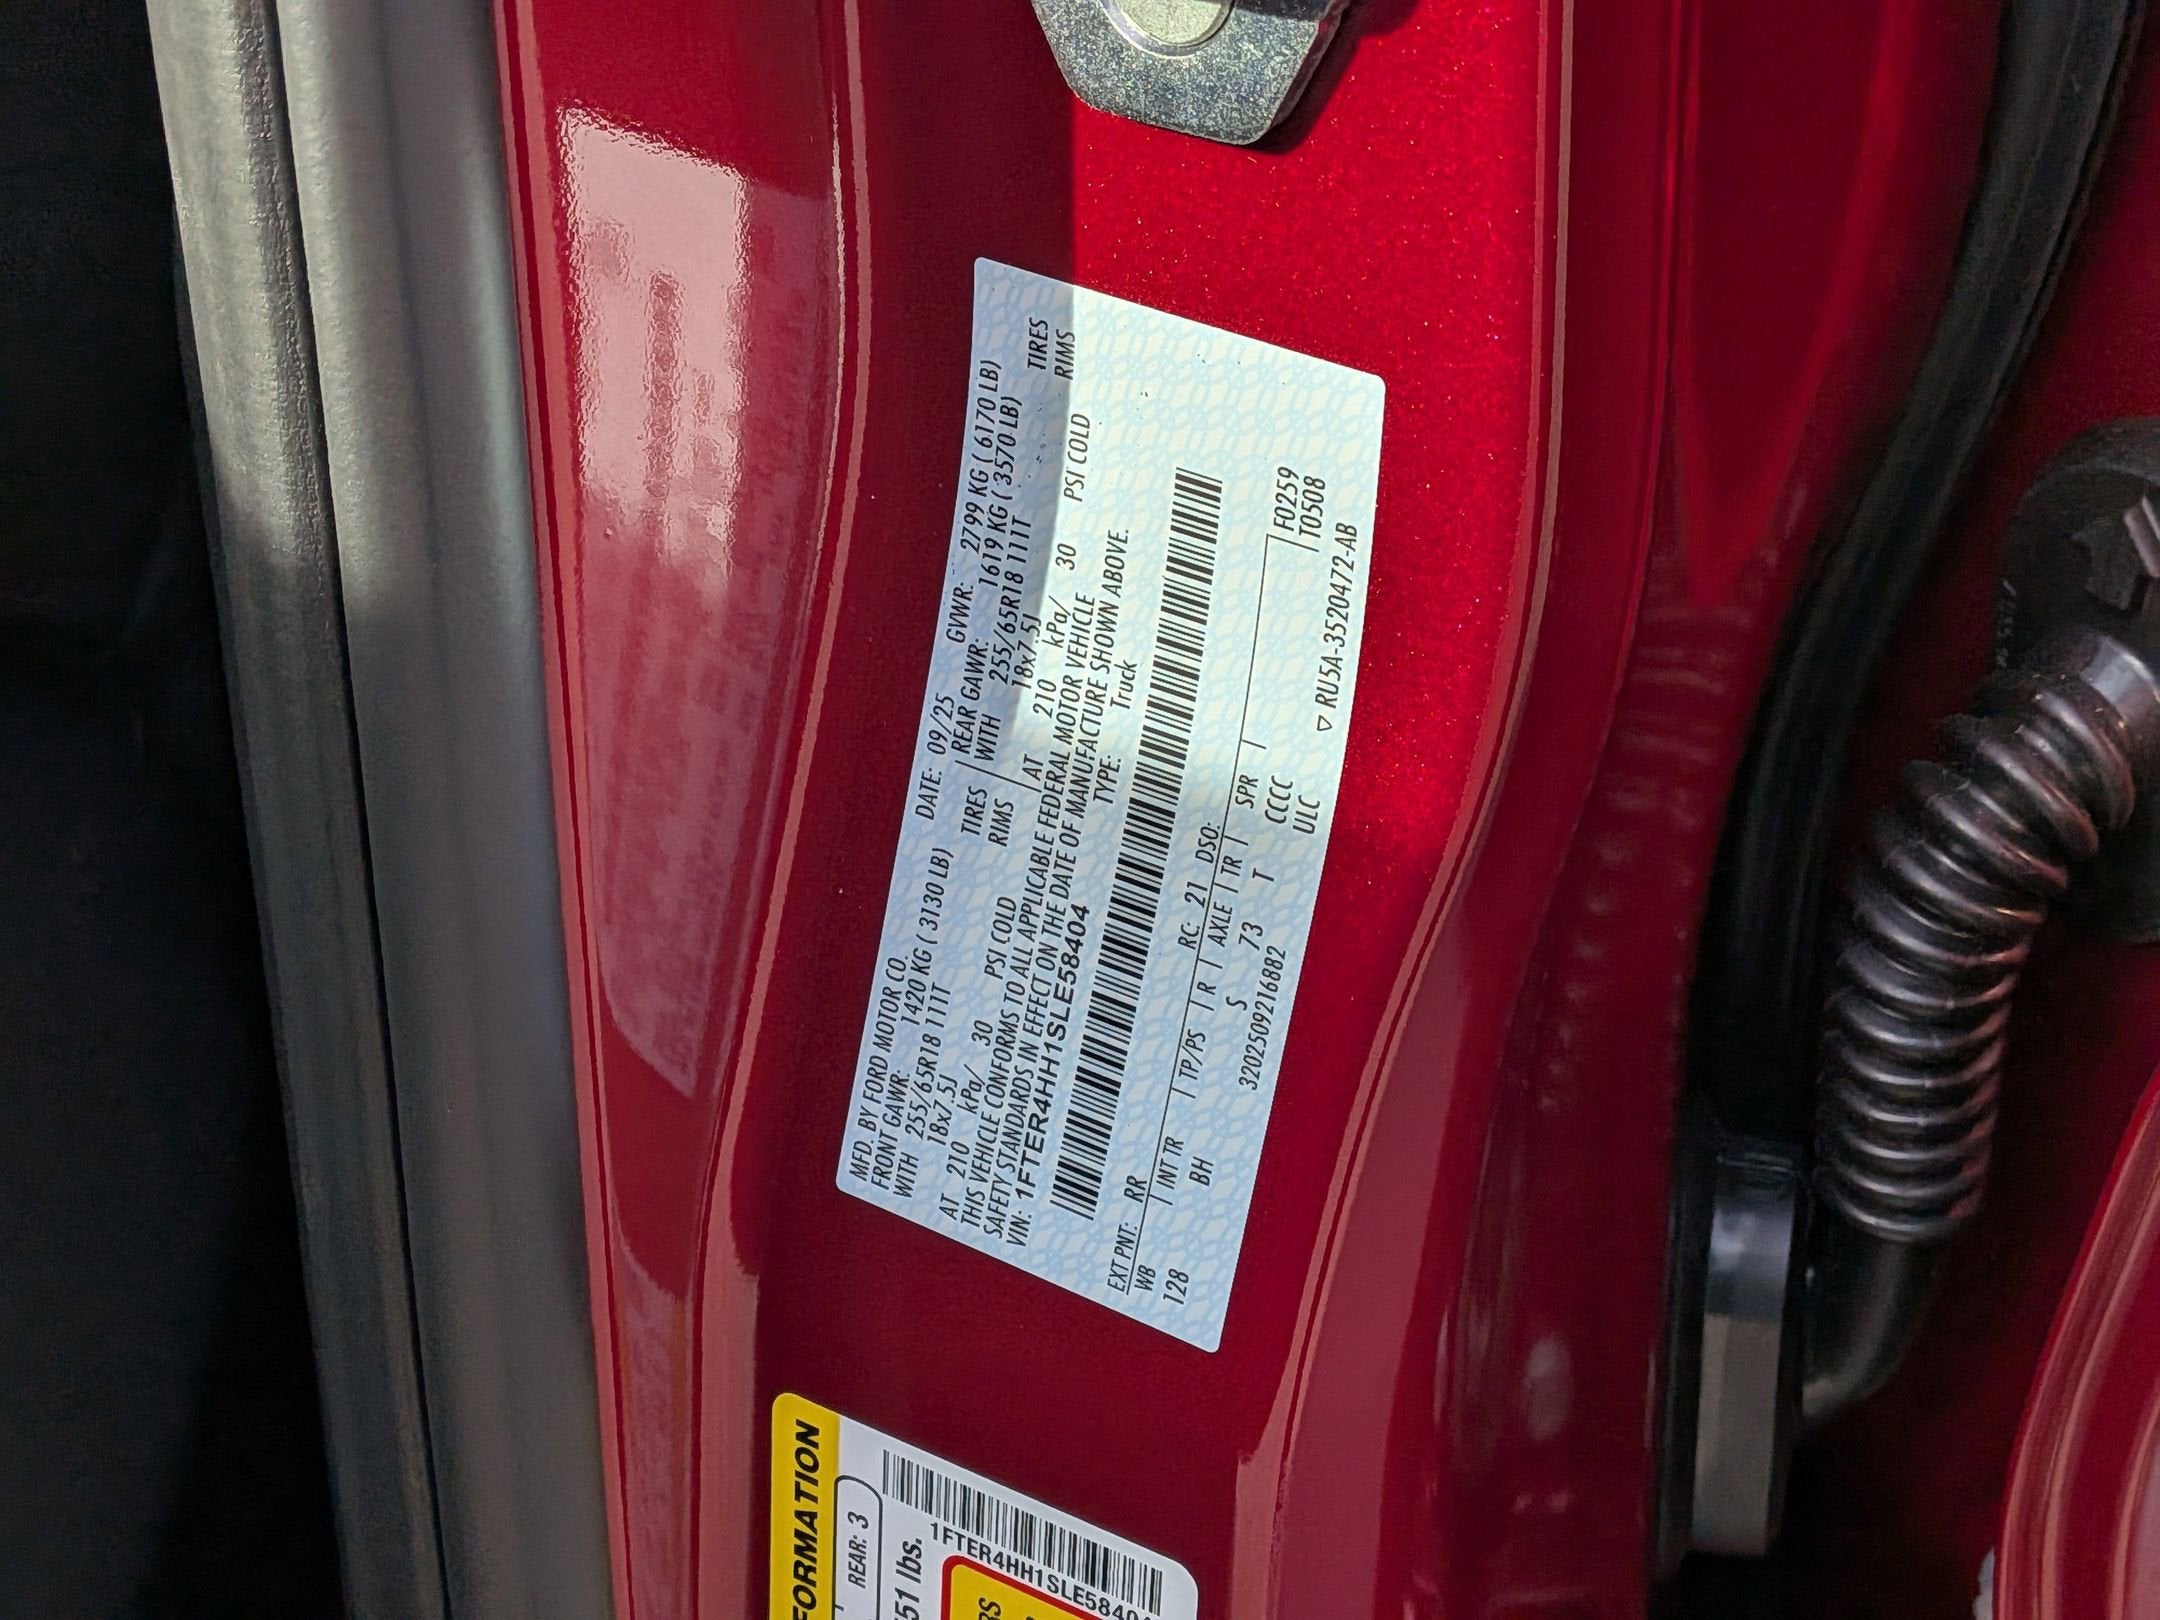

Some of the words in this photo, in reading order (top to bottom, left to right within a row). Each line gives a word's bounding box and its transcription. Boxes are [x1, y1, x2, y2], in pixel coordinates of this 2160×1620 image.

[1027, 317, 1049, 370] TIRES
[1054, 328, 1076, 381] RIMS
[978, 359, 1002, 393] LB)
[973, 396, 997, 449] 6170
[998, 395, 1023, 430] LB)
[992, 432, 1017, 486] 3570
[1067, 413, 1091, 465] COLD
[967, 468, 989, 498] KG
[1063, 469, 1086, 503] PSI
[1273, 466, 1300, 532] F0259
[1298, 475, 1326, 539] T0508
[959, 501, 985, 555] 2799
[986, 503, 1009, 534] KG
[978, 537, 1004, 588] 1619
[1055, 543, 1077, 571] 30
[1101, 529, 1129, 599] ABOVE.
[945, 582, 974, 644] GVWR:
[1041, 595, 1072, 649] kPa/
[1064, 592, 1096, 669] VEHICLE
[1314, 522, 1358, 709] RU5A-3520472-AB
[973, 713, 1001, 762] WITH
[988, 570, 1024, 686] 255/65R18
[1006, 514, 1032, 564] 111T
[1011, 612, 1042, 690] 18x7.5J
[1089, 600, 1120, 675] SHOWN
[959, 638, 989, 702] GAWR:
[1032, 678, 1057, 719] 210
[1052, 674, 1084, 746] MOTOR
[926, 692, 955, 755] 09/25
[950, 705, 978, 755] REAR
[1092, 754, 1122, 805] TYPE:
[1109, 659, 1138, 710] Truck
[1021, 753, 1044, 782] AT
[1064, 677, 1108, 820] MANUFACTURE
[914, 767, 943, 821] DATE:
[960, 785, 988, 836] TIRES
[1037, 750, 1071, 830] FEDERAL
[1234, 774, 1259, 810] SPR
[1264, 775, 1294, 825] CCCC
[987, 798, 1014, 848] RIMS
[1058, 819, 1082, 848] OF
[1292, 794, 1321, 835] ULC
[927, 847, 955, 880] LB)
[1194, 822, 1221, 864] DSO:
[1220, 855, 1243, 877] TR
[1016, 830, 1055, 944] APPLICABLE
[1048, 849, 1077, 900] DATE
[1183, 881, 1208, 909] 21
[1251, 867, 1275, 882] T
[918, 881, 945, 932] 3130
[990, 896, 1017, 945] COLD
[1040, 901, 1067, 938] THE
[1207, 900, 1233, 948] AXLE
[1035, 941, 1059, 972] ON
[1177, 921, 1201, 951] RC:
[1238, 921, 1264, 951] 73
[885, 956, 909, 983] CO.
[910, 947, 933, 977] KG
[983, 947, 1008, 980] PSI
[1009, 946, 1034, 980] ALL
[900, 978, 927, 1026] 1420
[925, 981, 951, 1028] 111T
[1002, 980, 1026, 1006] TO
[1022, 972, 1053, 1038] EFFECT
[1196, 981, 1217, 996] R
[1225, 995, 1248, 1011] S
[872, 986, 903, 1054] MOTOR
[970, 1019, 994, 1047] 30
[1238, 945, 1286, 1091] 3202509216882
[983, 1008, 1021, 1109] CONFORMS
[1014, 903, 1091, 1200] 1FTER4HH1SLE58404
[1016, 1039, 1040, 1064] IN
[1178, 1028, 1206, 1081] TP/PS
[862, 1054, 889, 1105] FORD
[881, 1069, 911, 1128] GAWR:
[904, 1033, 942, 1140] 255/65R18
[956, 1063, 986, 1115] kPa/
[857, 1104, 879, 1133] BY
[926, 1073, 958, 1146] 18x7.5J
[995, 1064, 1035, 1174] STANDARDS
[848, 1140, 874, 1182] MFD.
[870, 1128, 898, 1191] FRONT
[945, 1140, 971, 1180] 210
[968, 1110, 1001, 1184] VEHICLE
[1162, 1135, 1185, 1157] TR
[892, 1151, 919, 1198] WITH
[1123, 1175, 1148, 1204] RR
[1155, 1157, 1179, 1190] INT
[1188, 1155, 1214, 1187] BH
[938, 1192, 960, 1221] AT
[960, 1186, 986, 1228] THIS
[982, 1171, 1013, 1239] SAFETY
[1005, 1210, 1032, 1247] VIN:
[1113, 1222, 1138, 1261] PNT:
[1106, 1258, 1129, 1293] EXT
[1133, 1264, 1157, 1292] WB
[1162, 1268, 1190, 1305] 128
[848, 1511, 870, 1529] 3
[848, 1535, 867, 1589] REAR:
[896, 1538, 922, 1584] lbs.
[931, 1523, 1150, 1620] 1FTER4HH1SLE5840
[894, 1587, 920, 1620] 51
